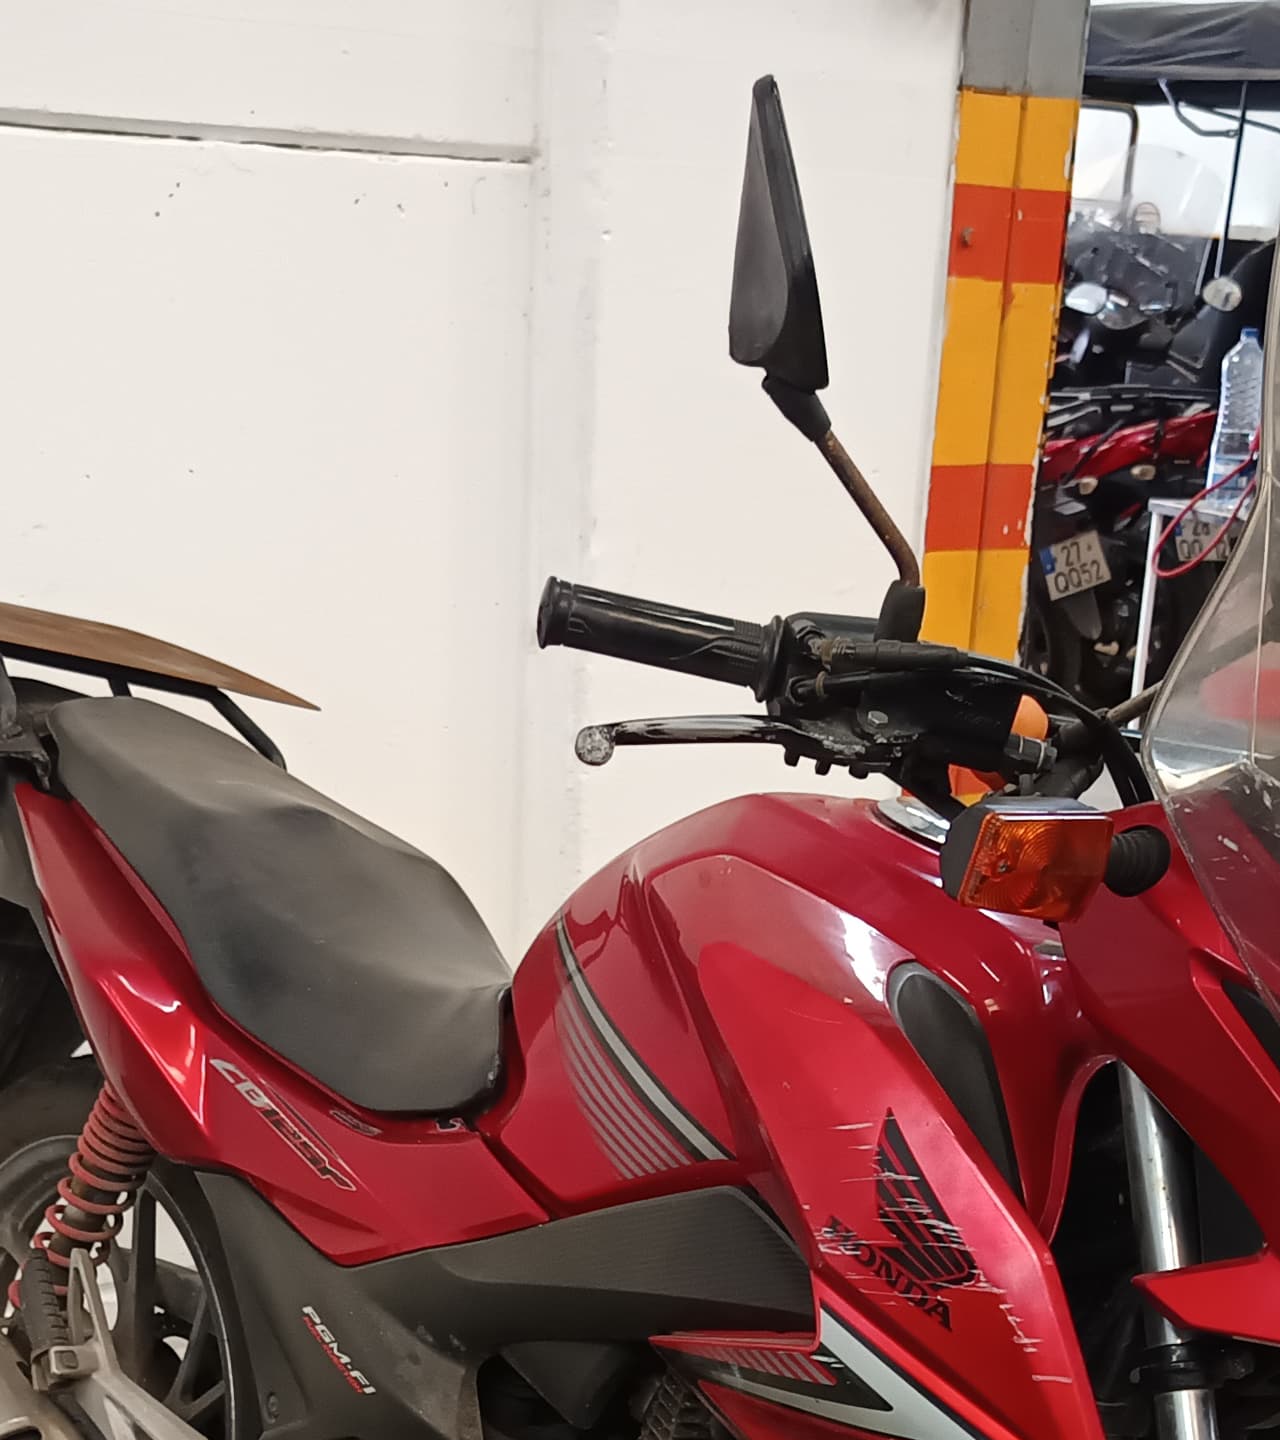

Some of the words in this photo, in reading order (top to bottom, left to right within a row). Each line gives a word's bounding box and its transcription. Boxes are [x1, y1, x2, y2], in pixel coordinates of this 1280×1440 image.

[1060, 541, 1081, 567] 27
[1054, 560, 1105, 594] QQ52
[821, 1214, 953, 1332] HONDA
